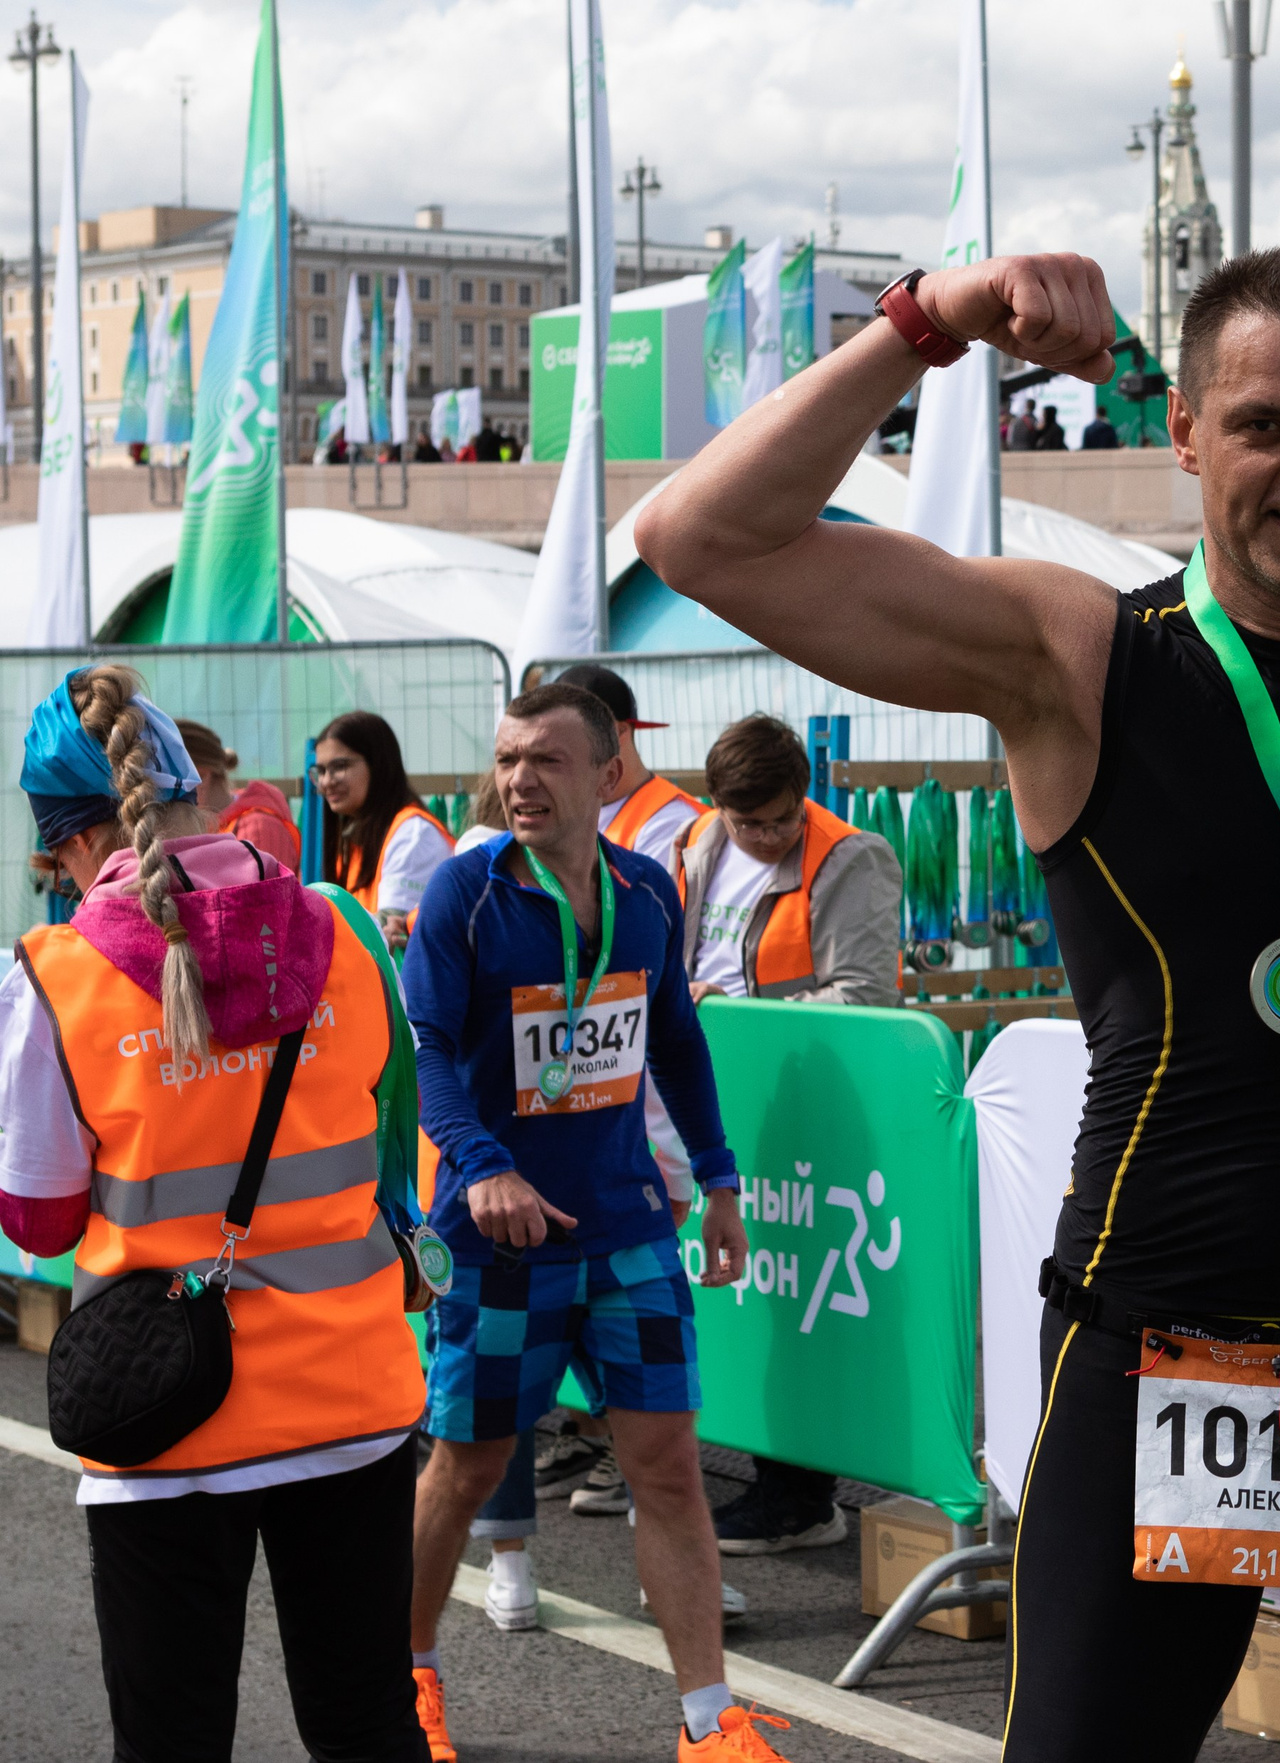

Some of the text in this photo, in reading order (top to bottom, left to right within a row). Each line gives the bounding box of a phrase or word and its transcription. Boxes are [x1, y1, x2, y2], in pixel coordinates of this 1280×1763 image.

[523, 1008, 641, 1063] 10347
[159, 1044, 318, 1087] ВОЛОНТР
[571, 1056, 618, 1076] ИКОЛАЙ
[1155, 1532, 1190, 1573] A
